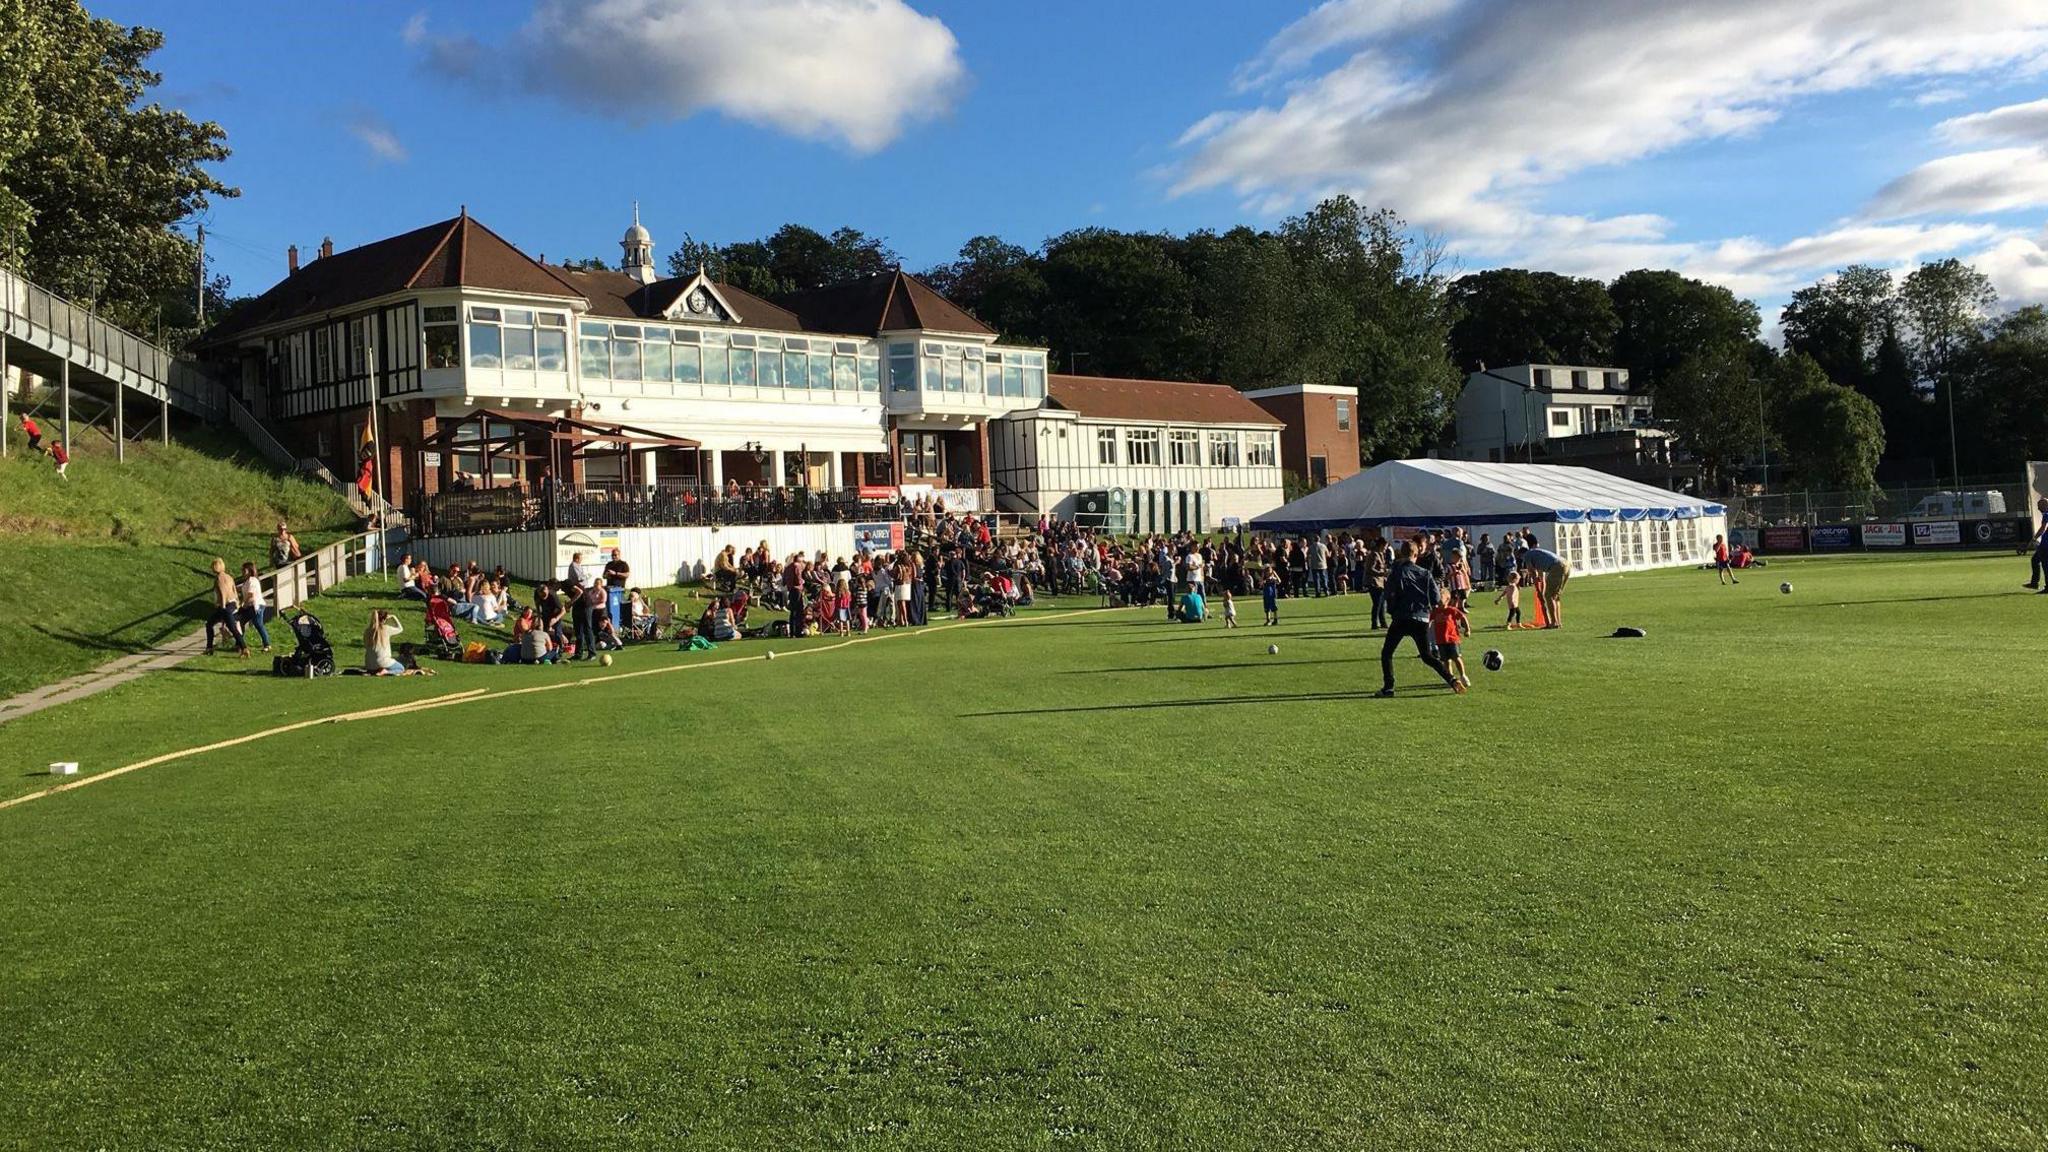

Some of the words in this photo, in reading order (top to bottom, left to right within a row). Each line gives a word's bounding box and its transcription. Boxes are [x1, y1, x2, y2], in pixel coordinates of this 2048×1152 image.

[872, 529, 890, 538] AIREY
[1864, 525, 1883, 534] JACK
[1888, 525, 1902, 533] JILL
